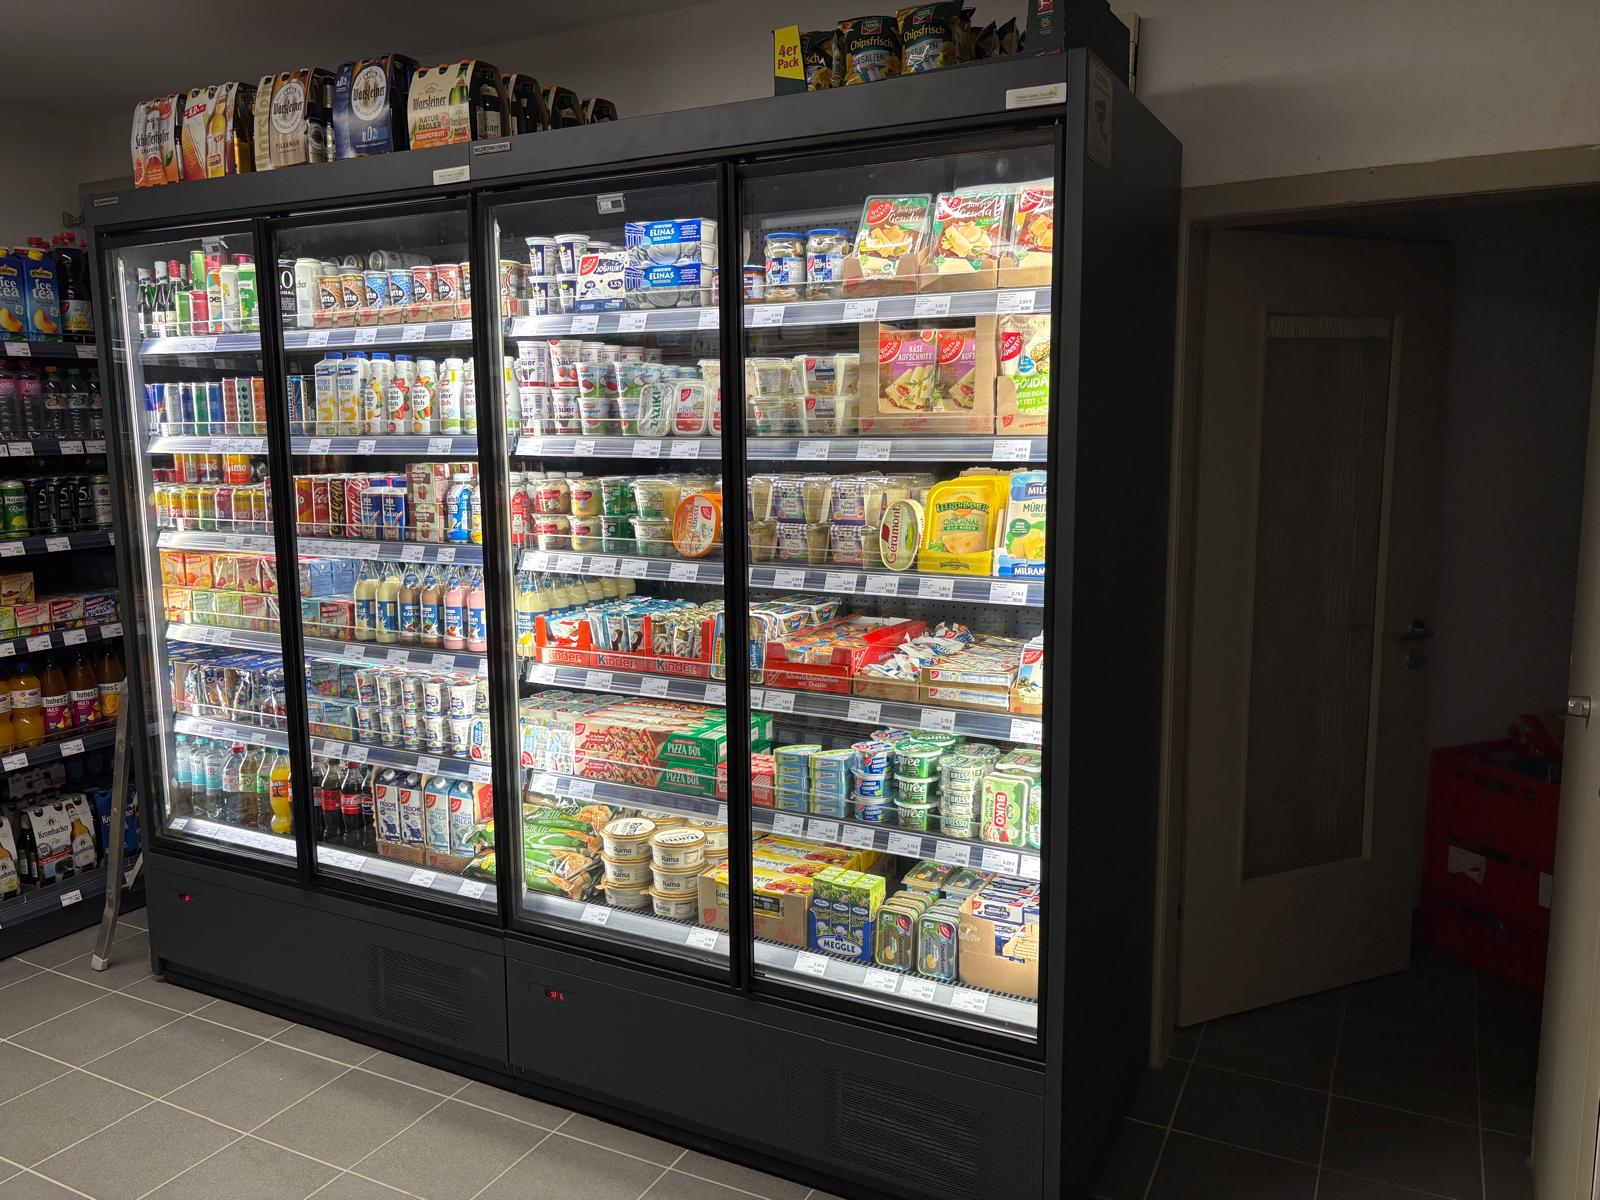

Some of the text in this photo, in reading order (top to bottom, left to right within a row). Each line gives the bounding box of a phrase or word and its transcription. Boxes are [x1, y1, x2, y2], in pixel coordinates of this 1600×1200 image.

[903, 25, 945, 42] Chipsfrisch
[851, 36, 893, 51] Chipsfrisch
[778, 45, 798, 57] 4er
[778, 58, 799, 69] Pack
[413, 95, 446, 111] Warsteiner
[419, 115, 438, 123] NATUR
[415, 131, 445, 141] GRAPEFRUIT
[889, 212, 920, 223] Gouda
[649, 228, 675, 236] ELINAS
[649, 271, 674, 280] ELINAS
[35, 279, 51, 290] ice
[32, 289, 54, 300] tea
[909, 344, 923, 353] KÄSE
[897, 352, 933, 361] AUFSCHNITT
[961, 352, 975, 361] AUFS
[650, 391, 662, 428] ZAZIKI
[935, 501, 990, 515] LEERDAMMER
[943, 518, 981, 527] ORIGINAL
[887, 504, 901, 564] Géramont
[667, 743, 701, 757] PIZZA BOX
[666, 772, 700, 787] PIZZA BOX
[995, 794, 1006, 825] BUKO
[38, 824, 69, 839] Krombacher
[613, 846, 632, 854] Rama
[661, 855, 680, 863] Rama
[662, 880, 681, 889] Rama
[823, 939, 856, 954] MEGGLE
